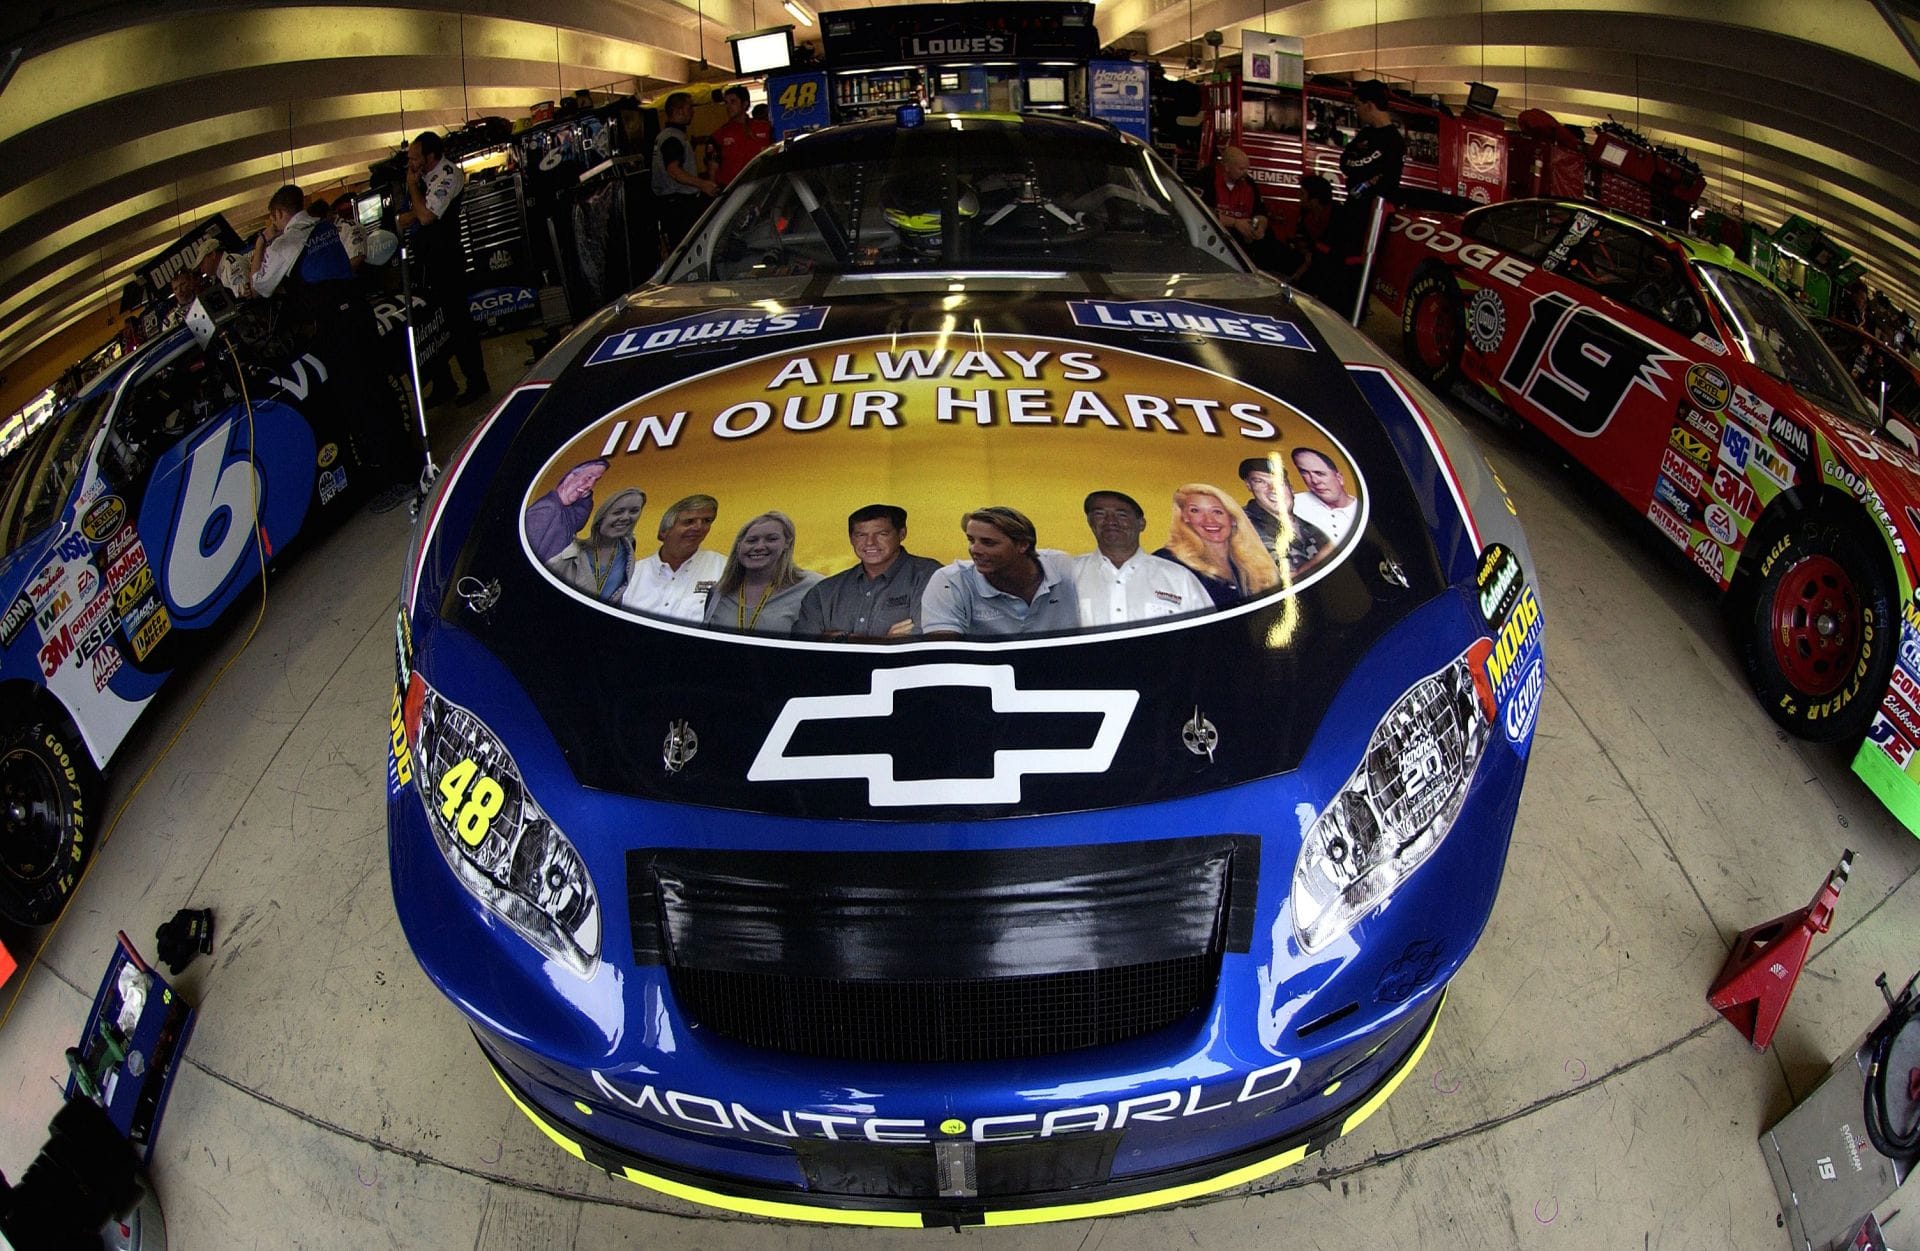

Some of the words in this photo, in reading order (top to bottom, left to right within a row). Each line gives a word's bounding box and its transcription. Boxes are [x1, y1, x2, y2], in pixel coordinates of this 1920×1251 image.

[912, 35, 1005, 56] LOWE'S
[778, 80, 818, 111] 48
[1462, 168, 1500, 185] DODGE
[1389, 213, 1536, 288] DODGE
[469, 288, 534, 312] AGRA
[612, 313, 802, 357] LOWE'S
[1093, 303, 1288, 343] LOWE'S
[765, 349, 1103, 391] ALWAYS
[1501, 290, 1690, 438] 19
[599, 411, 688, 458] IN
[711, 390, 900, 440] OUR
[936, 386, 1278, 440] HEARTS
[1688, 409, 1719, 434] BUD
[1771, 415, 1809, 456] MBNA
[1723, 424, 1750, 469] USG
[1753, 443, 1789, 483] WM
[1663, 451, 1701, 489] Holley
[167, 416, 263, 610] 6
[1714, 469, 1754, 518] 3M
[1823, 460, 1906, 556] GOODYEAR
[107, 525, 133, 554] BUD
[1650, 503, 1690, 543] OUTBACK
[1710, 507, 1731, 536] EA
[57, 530, 90, 563] USG
[108, 544, 145, 583] Holley
[1477, 545, 1503, 588] GOODYEAR
[1693, 552, 1723, 582] TOOLS
[1695, 540, 1724, 575] MAC
[1760, 534, 1793, 577] EAGLE
[77, 569, 96, 593] EA
[1479, 552, 1520, 621] Gatorback
[0, 597, 33, 642] MBNA
[38, 591, 72, 632] WM
[72, 589, 111, 636] OUTBACK
[40, 624, 75, 679] 3M
[75, 609, 122, 669] JESEL
[1485, 585, 1540, 694] MOOG
[92, 645, 120, 685] MAC
[97, 658, 124, 690] TOOLS
[1806, 607, 1875, 721] GOODYEAR
[1506, 662, 1544, 740] CLEVITE
[1779, 693, 1798, 716] #1
[1882, 694, 1920, 739] Edelbrock
[1398, 732, 1434, 773] Hendrick
[1869, 720, 1911, 766] JE
[1401, 747, 1443, 800] 20
[1408, 774, 1444, 806] YEARS
[44, 733, 84, 863] GOODYEAR
[438, 756, 506, 848] 48
[590, 1068, 932, 1144] MONTE
[971, 1056, 1302, 1143] CARLO
[1816, 1156, 1837, 1181] 19
[1840, 1123, 1863, 1172] EVERNHAM
